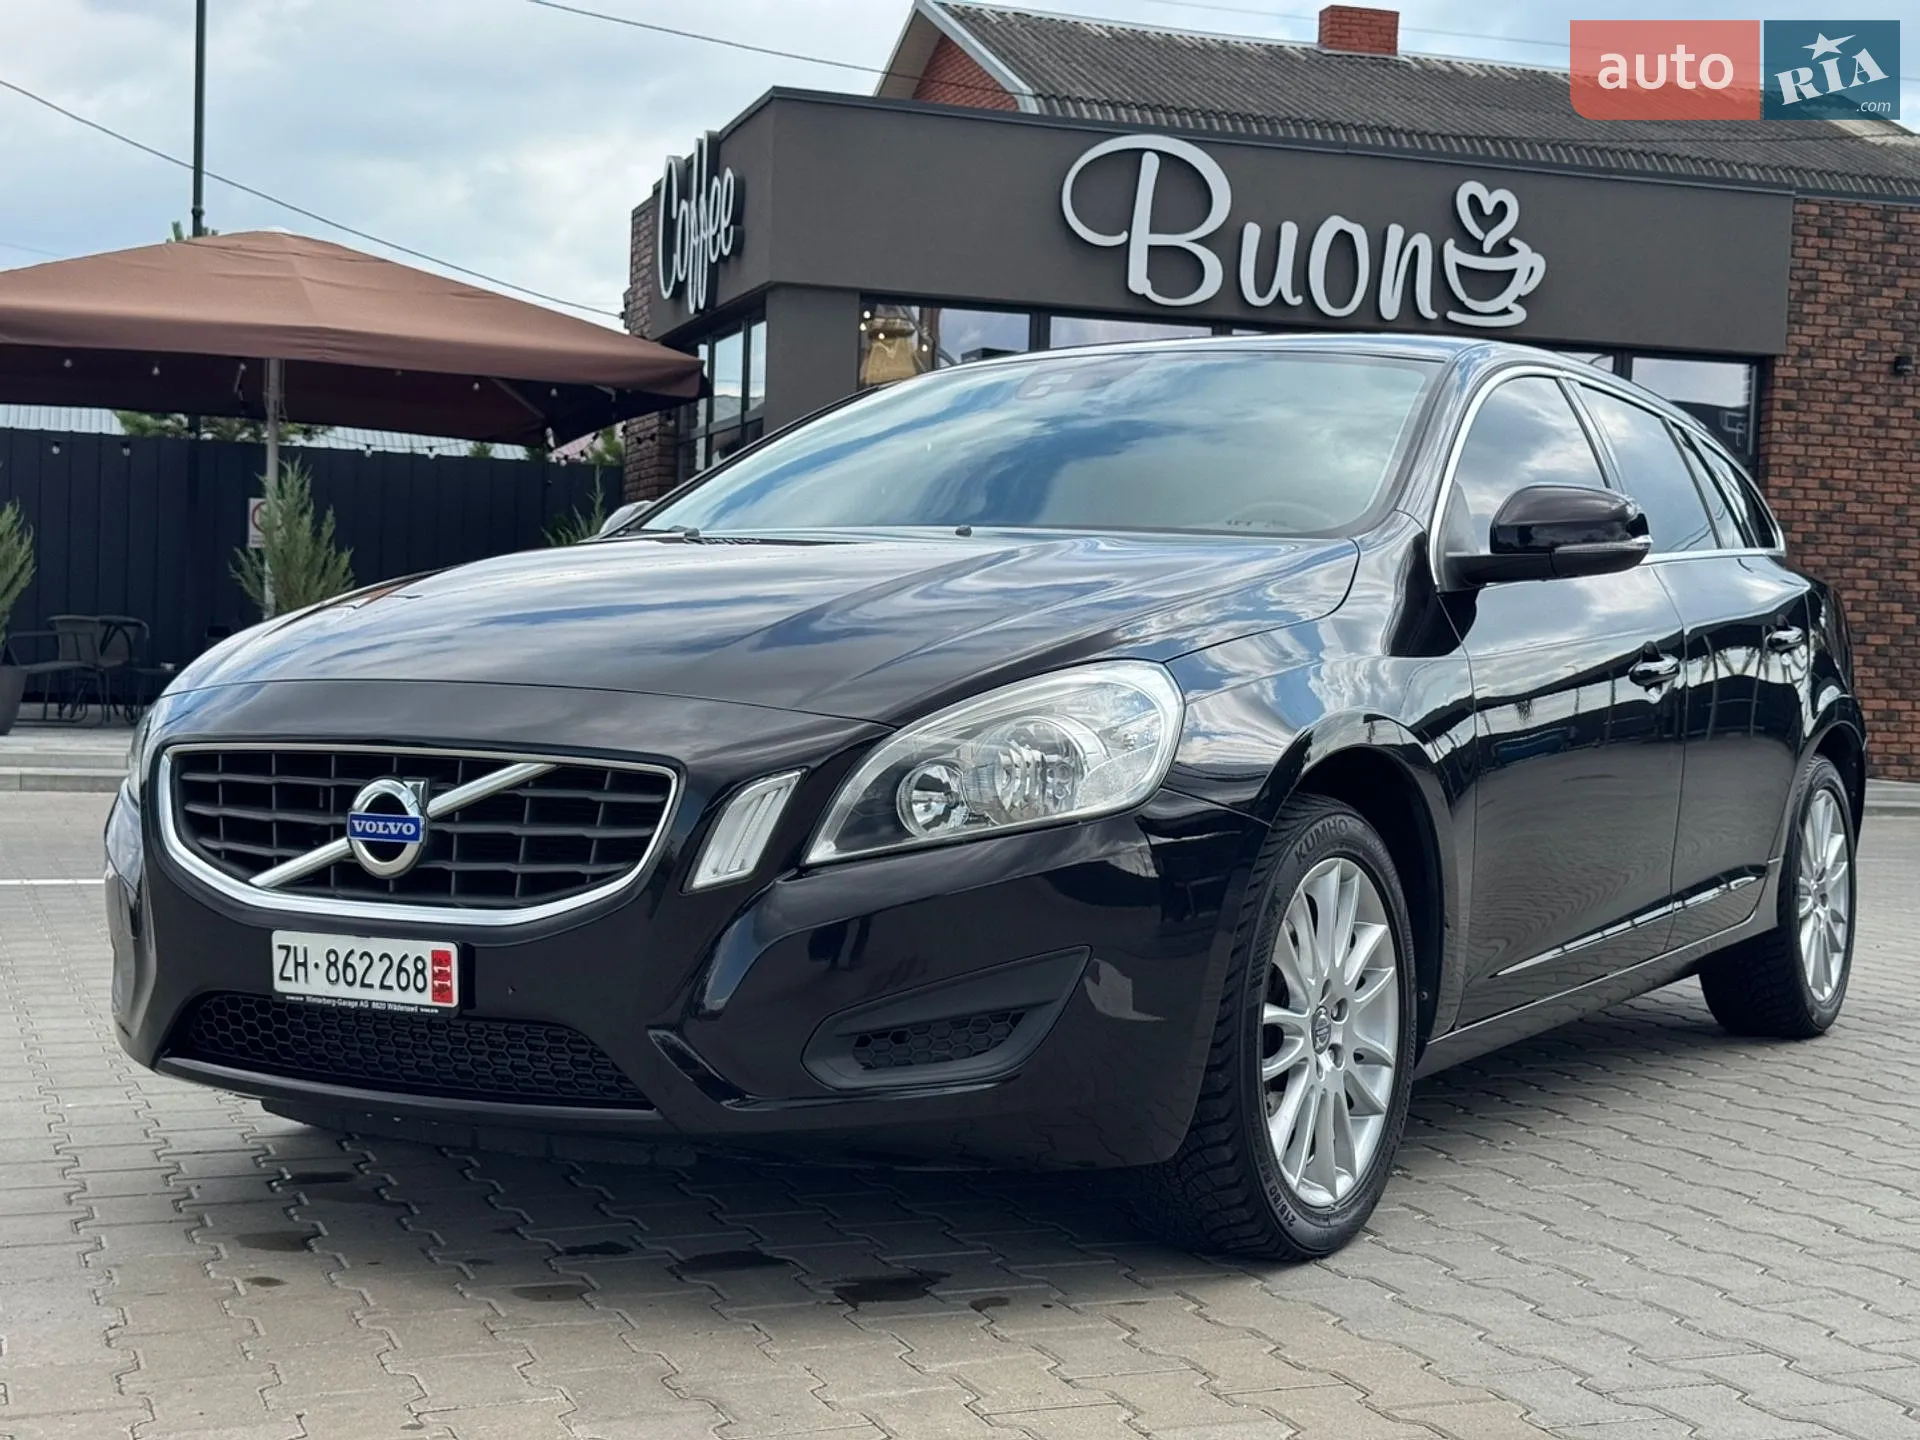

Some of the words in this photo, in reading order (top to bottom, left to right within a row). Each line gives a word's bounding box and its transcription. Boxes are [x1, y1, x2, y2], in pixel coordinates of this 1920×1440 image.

[658, 131, 735, 315] Coffee
[352, 819, 416, 836] VOLVO
[1295, 818, 1349, 865] KUMHO
